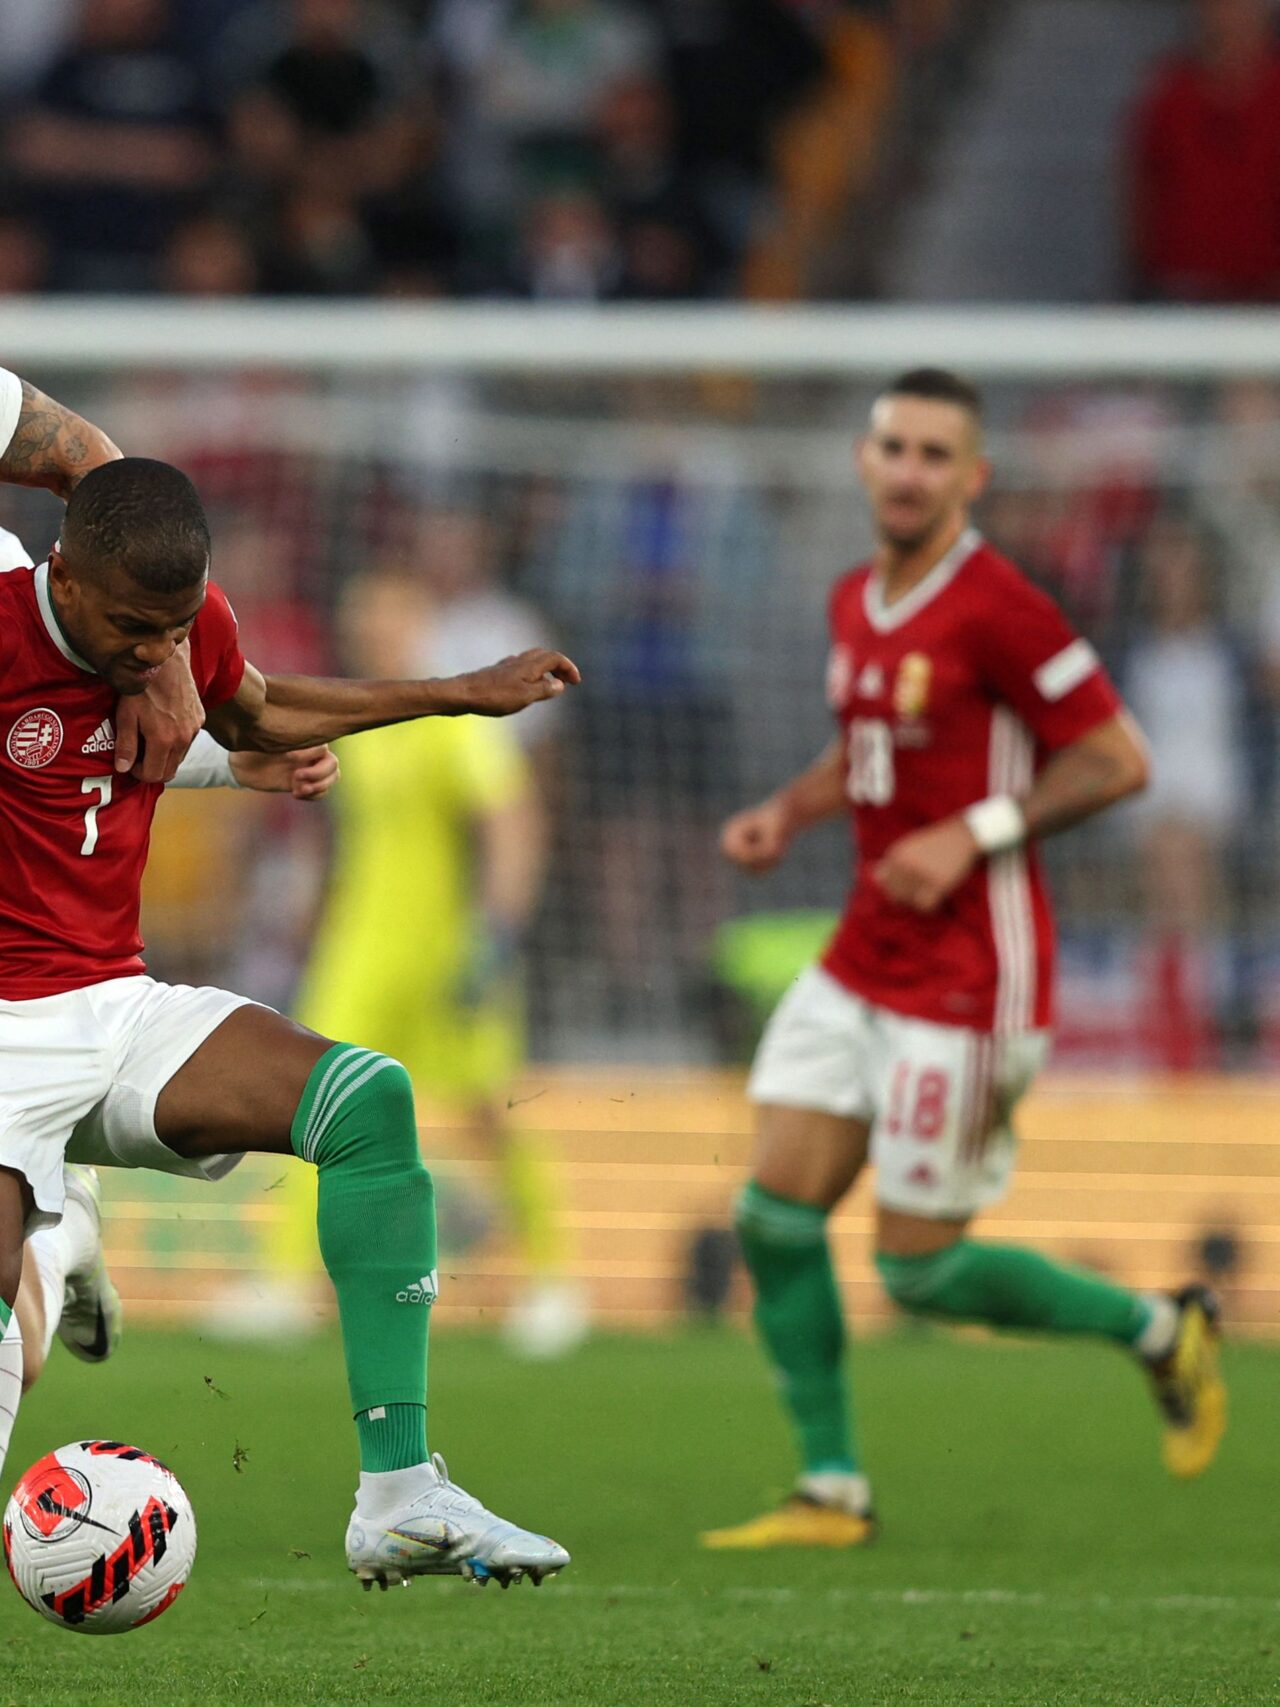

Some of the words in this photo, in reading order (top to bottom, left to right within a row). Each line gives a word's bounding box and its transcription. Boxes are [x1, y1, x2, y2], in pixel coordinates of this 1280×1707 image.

[81, 740, 115, 754] adida
[80, 774, 113, 856] 7
[886, 1060, 951, 1141] 18
[395, 1290, 437, 1305] adid
